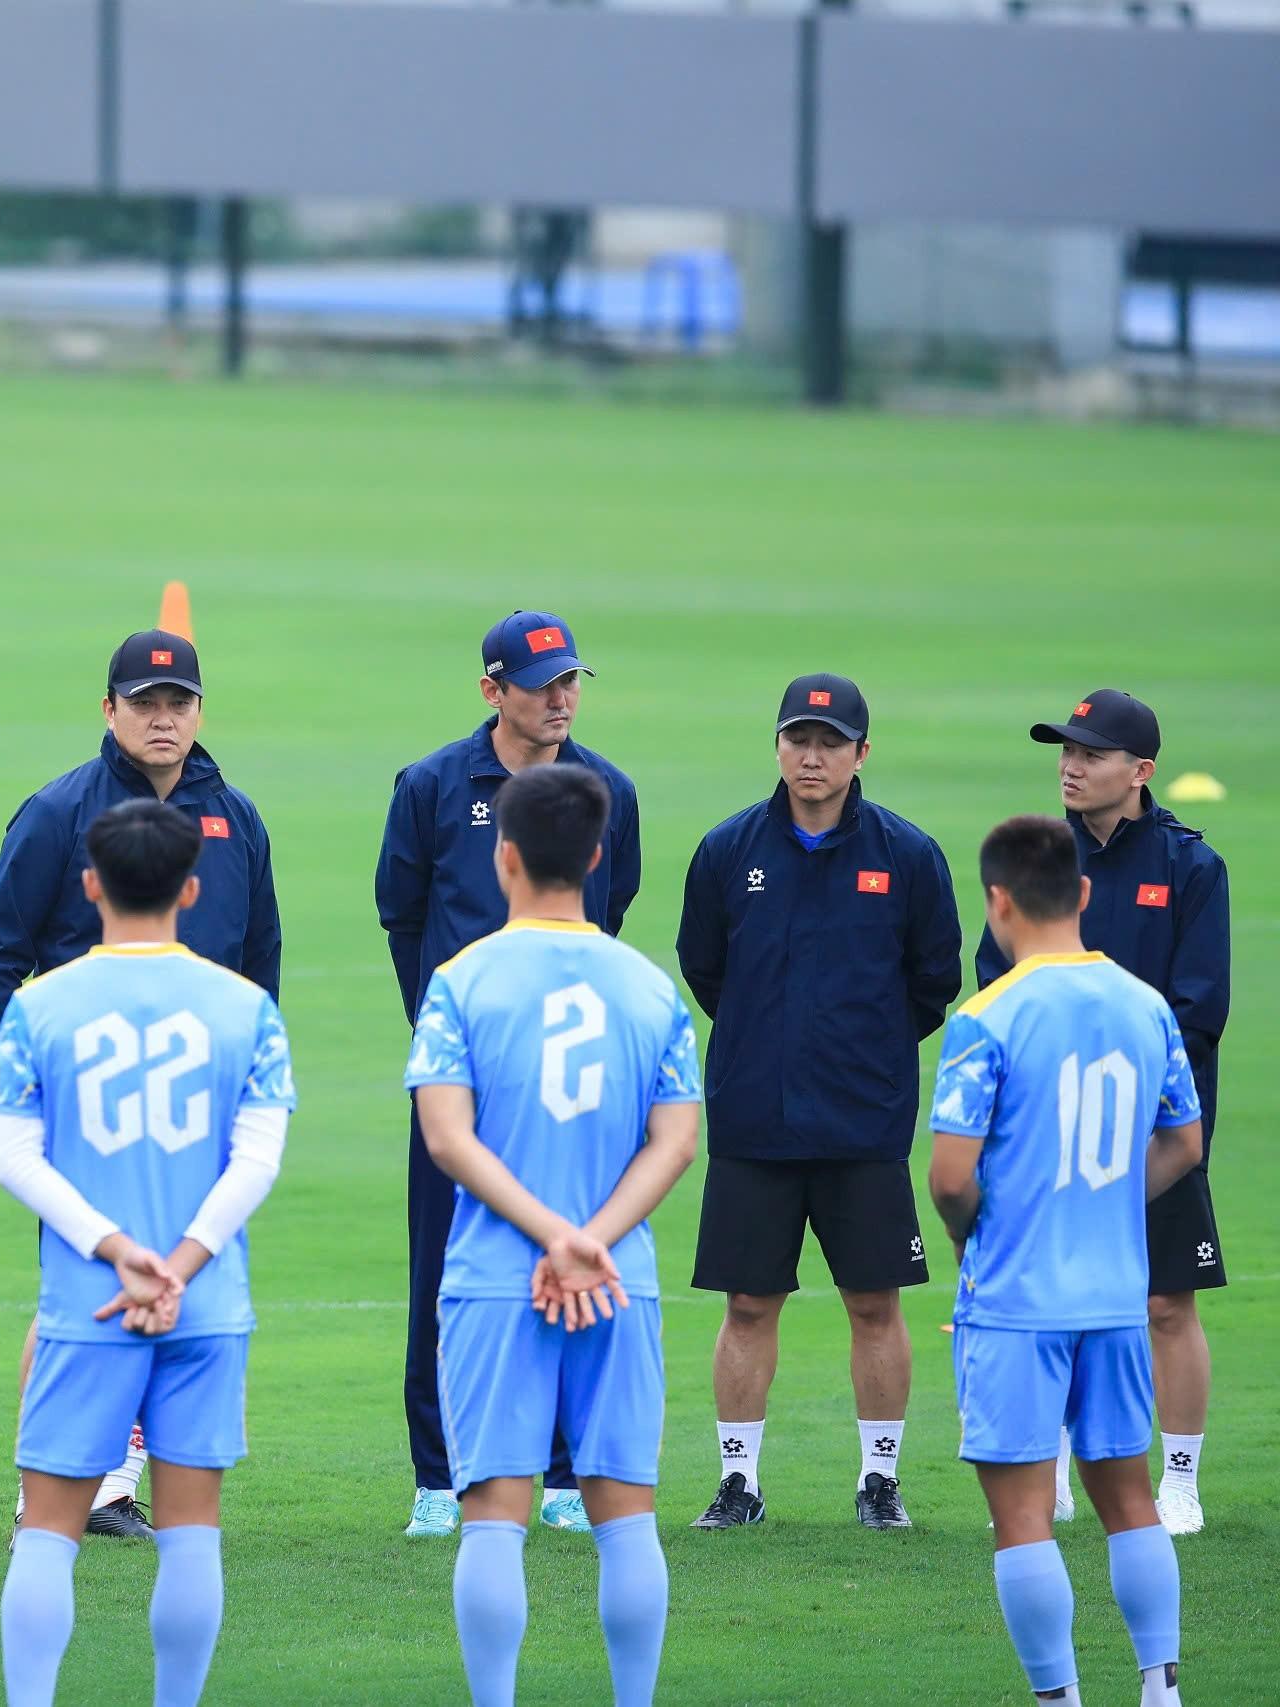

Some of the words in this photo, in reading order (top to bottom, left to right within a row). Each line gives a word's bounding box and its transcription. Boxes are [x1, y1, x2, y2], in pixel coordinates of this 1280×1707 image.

[74, 1008, 211, 1157] 22
[540, 981, 607, 1123] 2
[1053, 1049, 1137, 1192] 10
